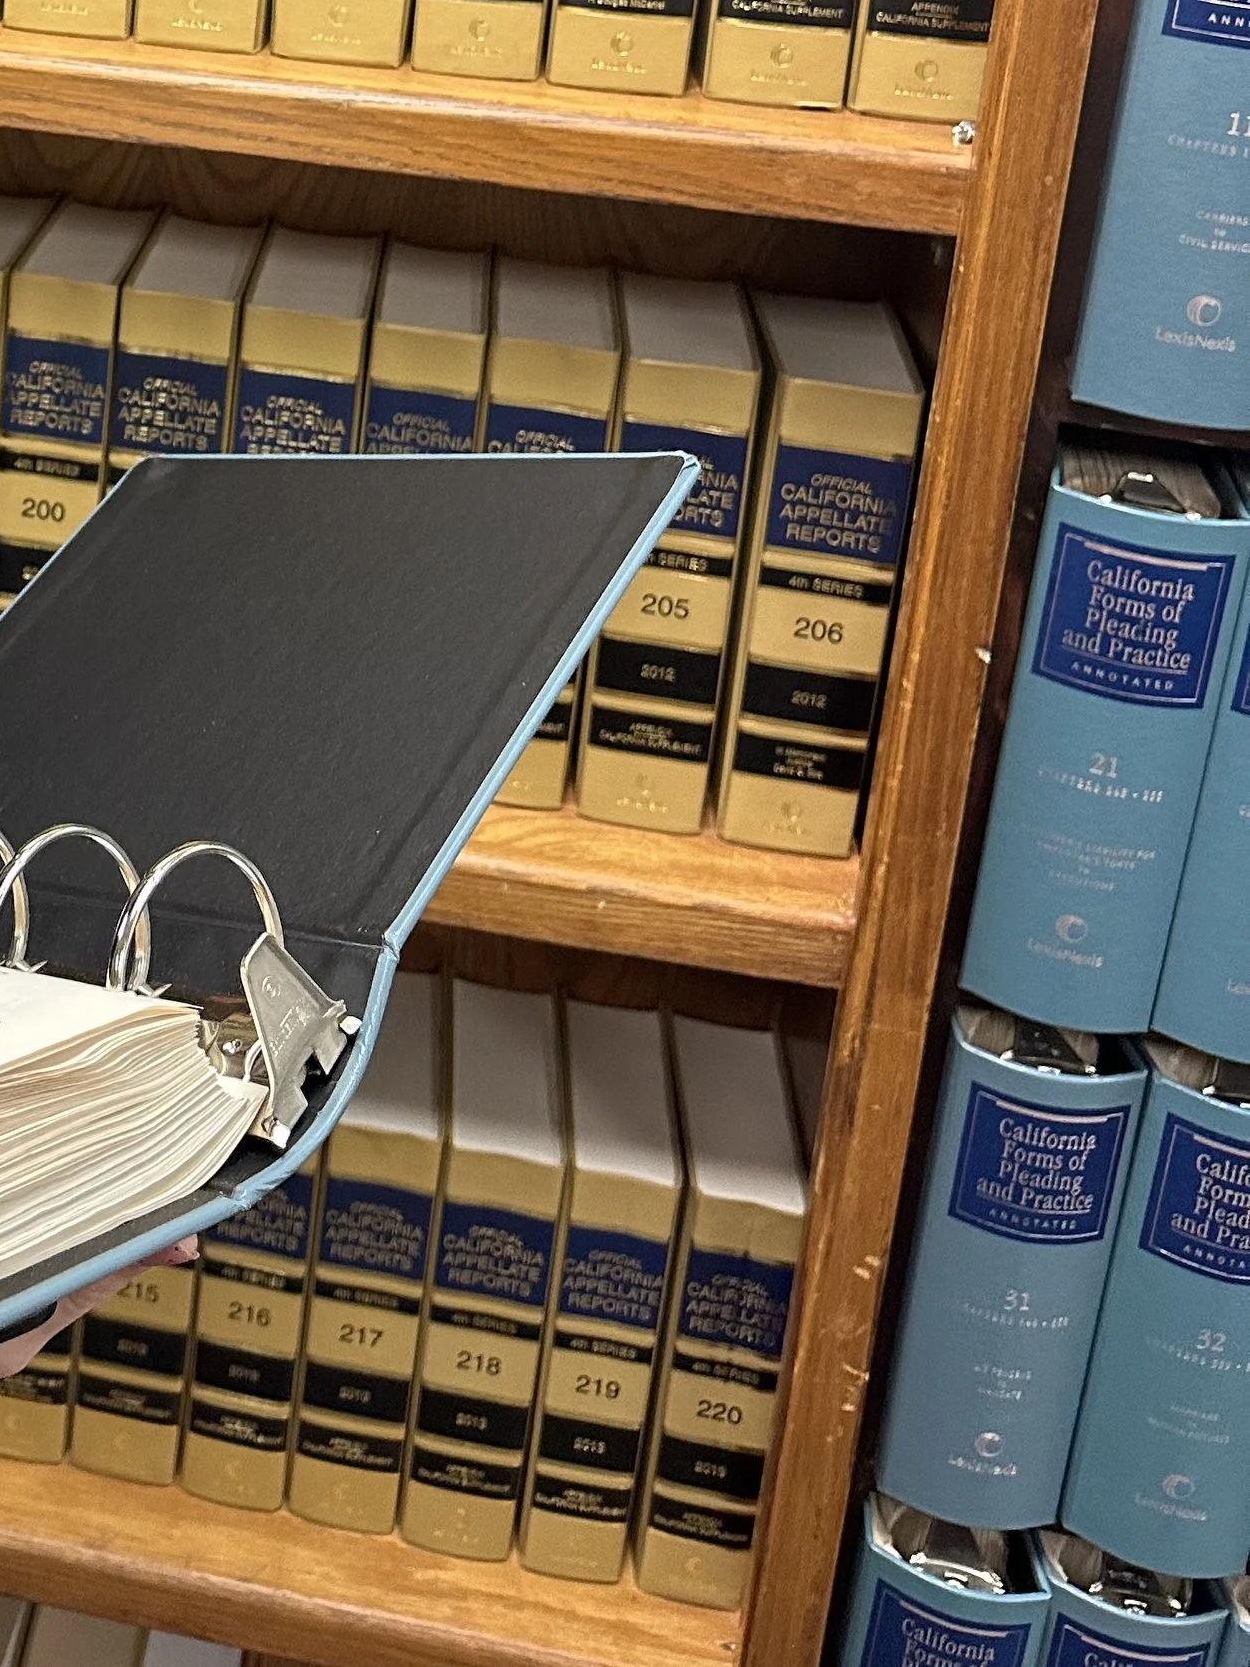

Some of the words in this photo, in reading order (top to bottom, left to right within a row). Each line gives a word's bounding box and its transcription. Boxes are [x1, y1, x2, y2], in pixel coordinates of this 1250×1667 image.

[1155, 326, 1236, 353] LexisNexis
[117, 387, 221, 417] CALIFORNIA
[118, 407, 216, 435] APPELLATE
[392, 411, 451, 433] OFFICIAL
[123, 424, 209, 452] REPORTS
[365, 422, 473, 452] CALIFORNIA
[810, 473, 873, 494] OFFICIAL
[21, 497, 66, 522] 200
[780, 483, 898, 516] CALIFORNIA
[779, 505, 891, 533] APPELLATE
[785, 524, 881, 553] REPORTS
[1087, 559, 1194, 602] California
[640, 593, 690, 620] 205
[1090, 585, 1155, 619] Forms
[1162, 601, 1185, 624] of
[793, 617, 844, 644] 206
[1085, 608, 1179, 652] Pleading
[1062, 628, 1100, 654] and
[1109, 642, 1191, 671] Practice
[1070, 661, 1174, 691] ANNOTATED
[1089, 751, 1118, 779] 21
[999, 1117, 1097, 1151] California
[1003, 1139, 1063, 1171] Forms
[1069, 1148, 1089, 1171] of
[999, 1160, 1084, 1195] Pleading
[976, 1177, 1014, 1202] and
[1020, 1188, 1093, 1210] Practice
[1171, 1212, 1209, 1240] and
[227, 1300, 273, 1327] 216
[1004, 1289, 1031, 1311] 31
[338, 1323, 385, 1349] 217
[1196, 1328, 1227, 1352] 32
[456, 1349, 502, 1376] 218
[575, 1374, 621, 1400] 219
[697, 1398, 744, 1425] 220
[900, 1618, 996, 1662] California
